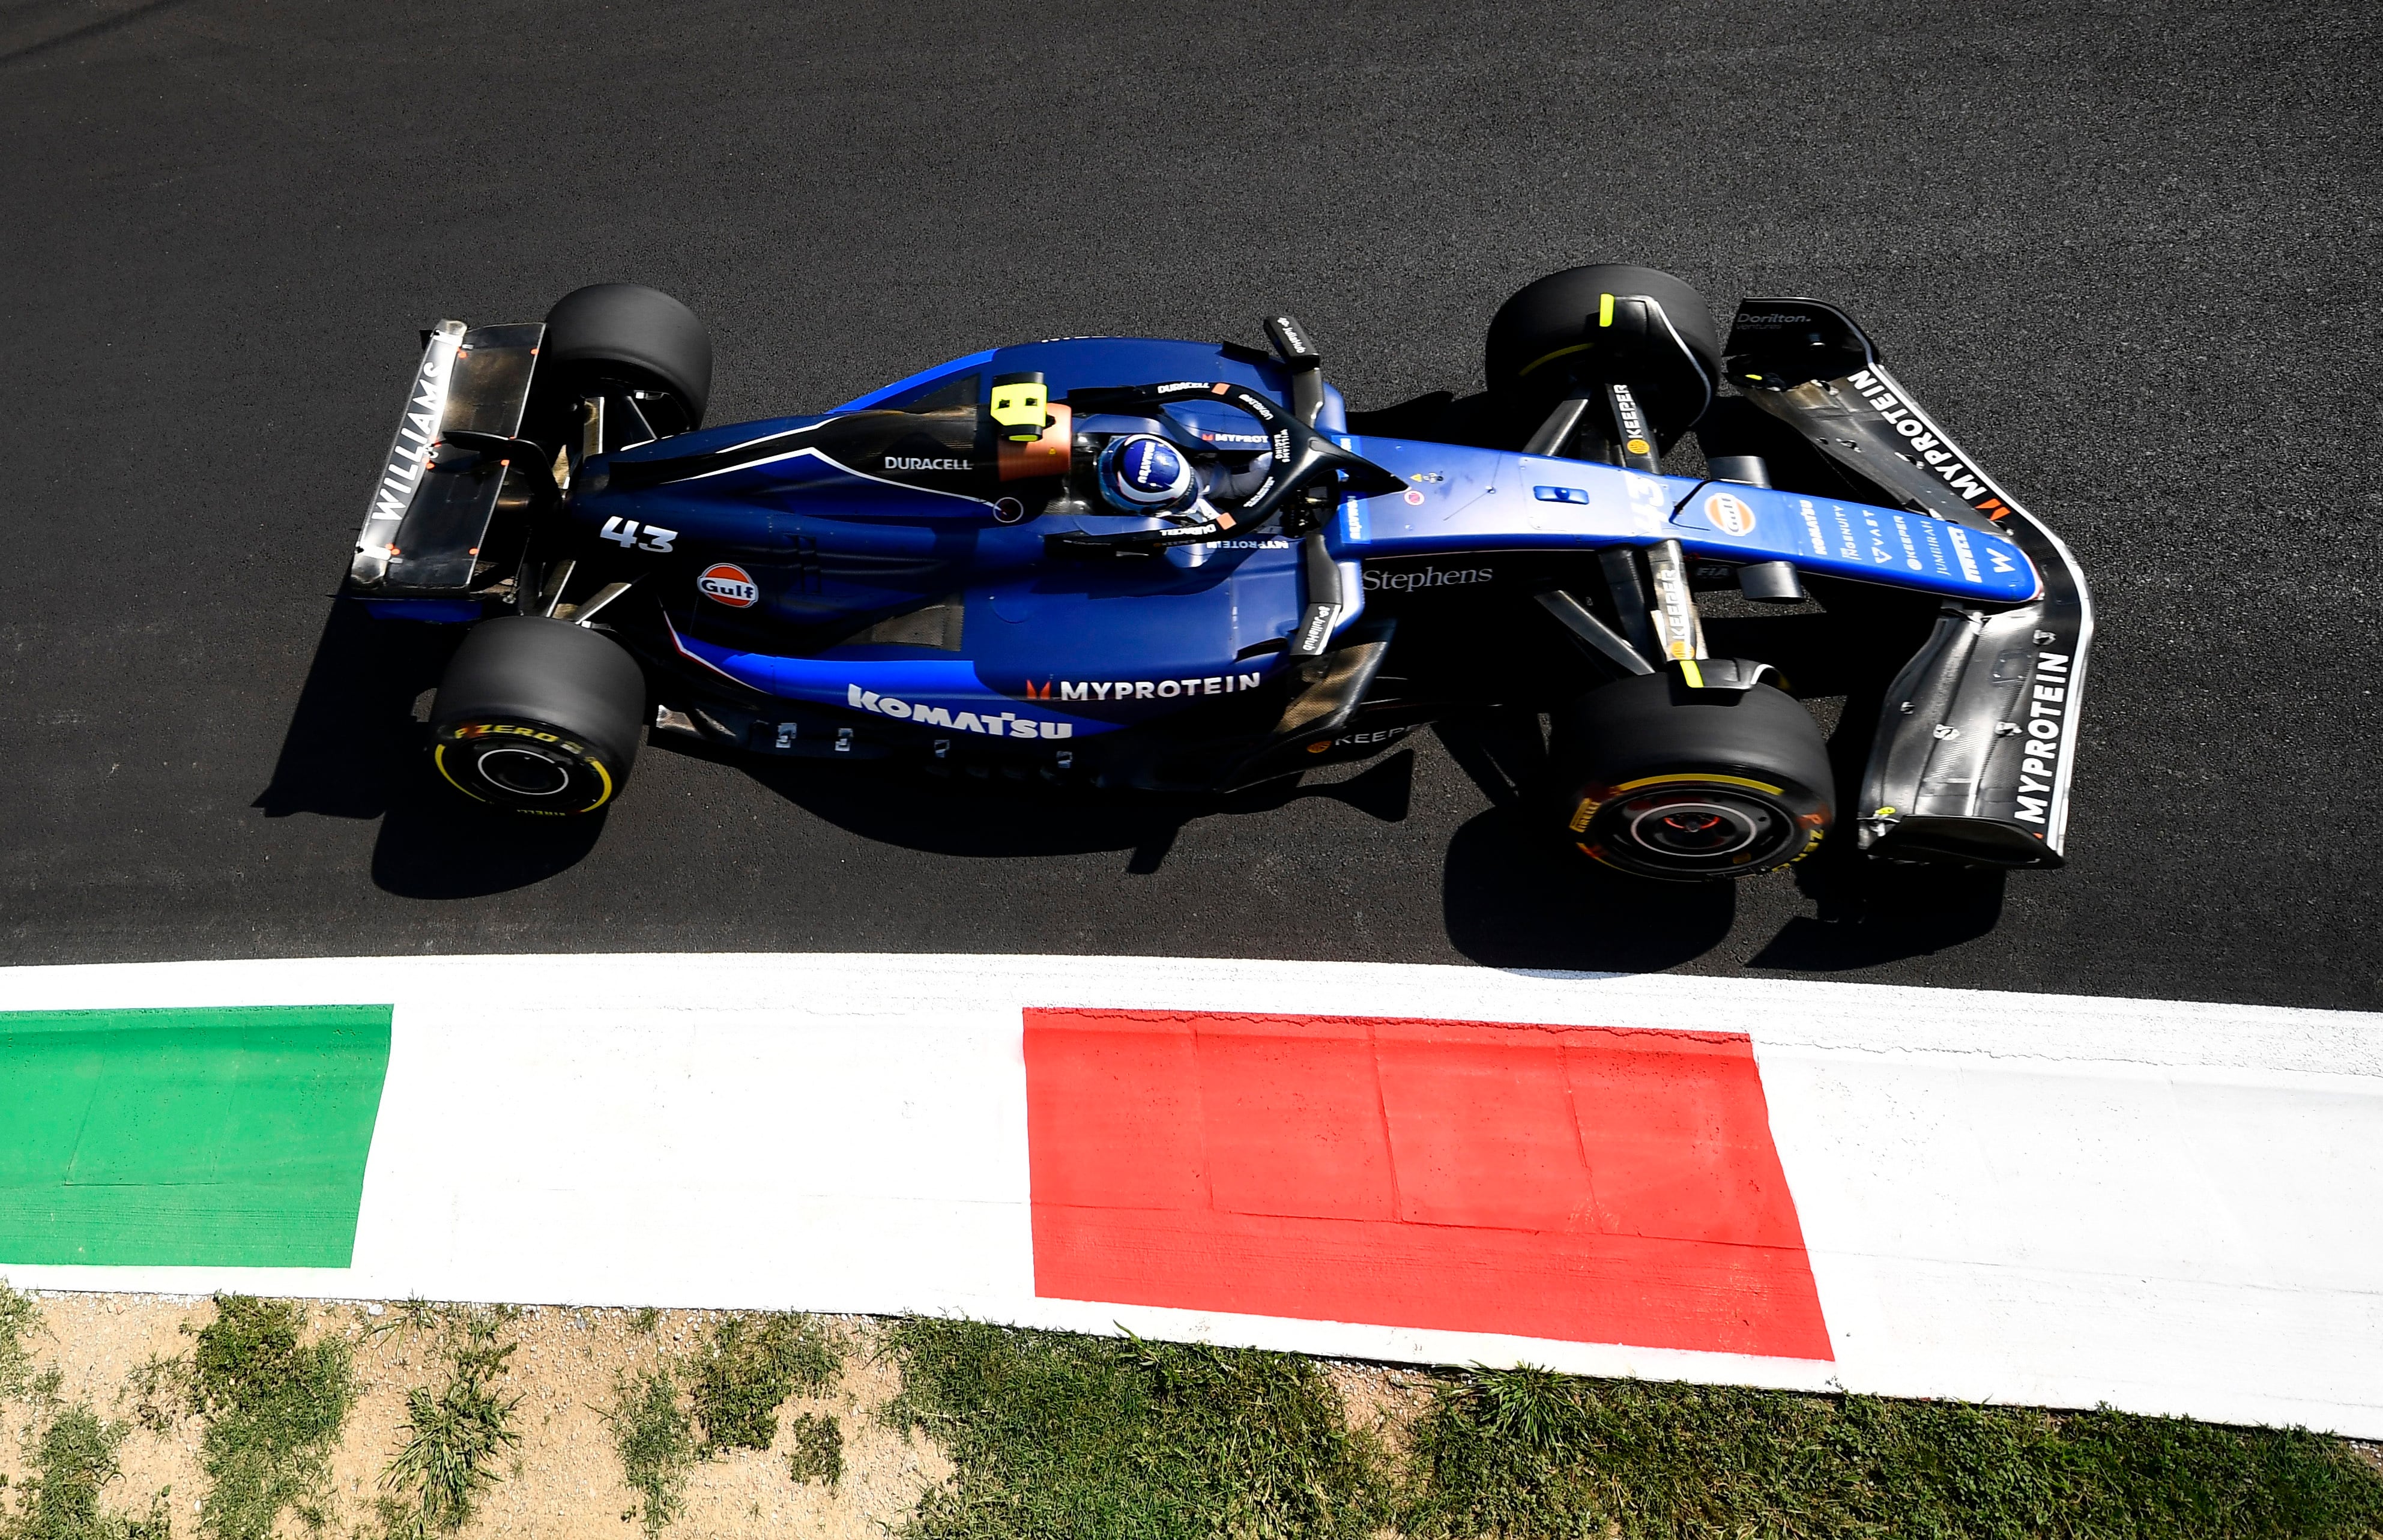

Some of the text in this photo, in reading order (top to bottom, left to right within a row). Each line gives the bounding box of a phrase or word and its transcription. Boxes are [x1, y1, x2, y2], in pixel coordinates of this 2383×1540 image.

[1158, 382, 1210, 393] DURACELL
[1613, 384, 1643, 439] KEEPER
[371, 362, 442, 520] WILLIAMS
[1281, 429, 1290, 462] WILLIAMS
[1847, 370, 1987, 500] MYPROTEIN
[884, 456, 973, 470] DURACELL
[1137, 441, 1156, 483] KOMATSU
[600, 516, 678, 553] 43
[1159, 524, 1216, 536] DURACELL
[1207, 540, 1289, 549] MYPROTEIN
[1799, 500, 1828, 555] KOMATSU
[1893, 515, 1917, 558] KEEPER
[701, 579, 754, 599] Gulf
[1363, 566, 1493, 592] Stephens
[1061, 672, 1261, 701] MYPROTEIN
[847, 684, 1072, 739] KOMATSU
[475, 724, 560, 742] ZERO
[2014, 652, 2069, 823] MYPROTEIN
